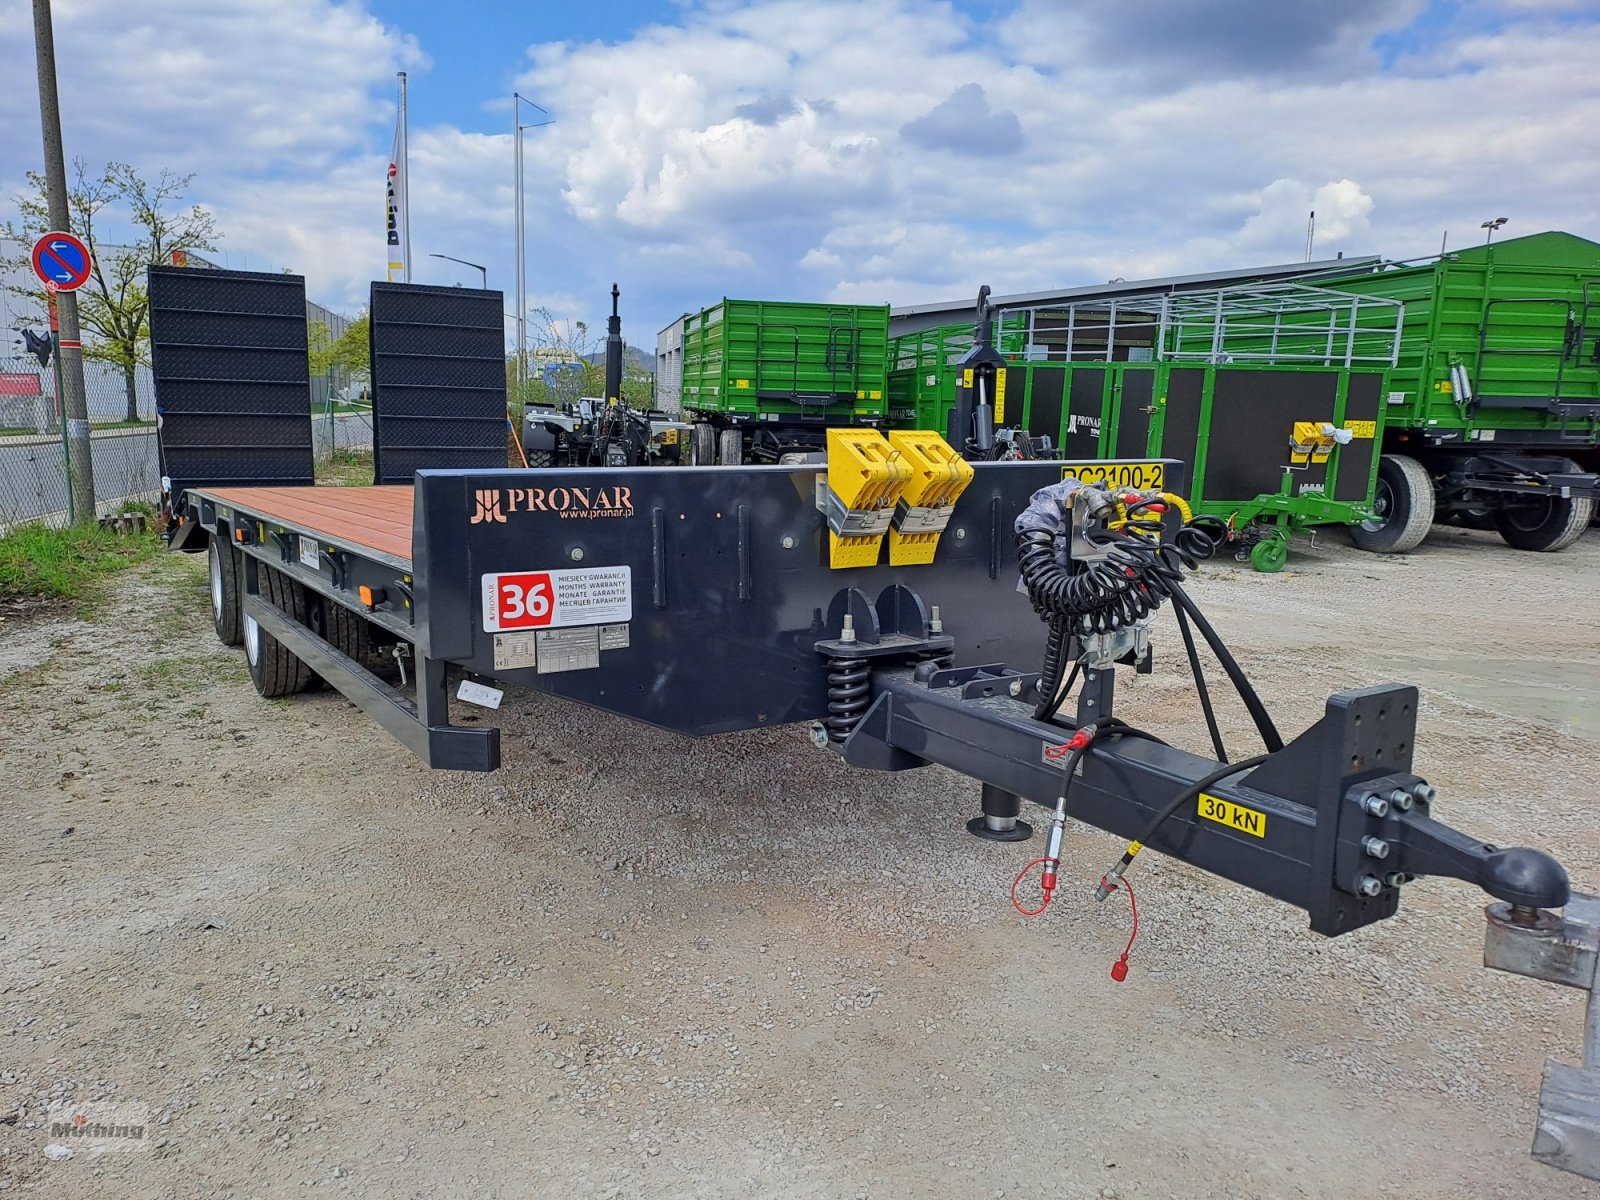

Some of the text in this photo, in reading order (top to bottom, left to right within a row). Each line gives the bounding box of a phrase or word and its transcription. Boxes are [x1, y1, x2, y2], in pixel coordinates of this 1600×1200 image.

[506, 486, 632, 512] PRONAR
[559, 507, 634, 520] www.pronar.pl
[558, 572, 626, 583] MIESIĘCY GWARANCJI
[558, 581, 626, 591] MONTHS WARRANTY
[488, 583, 496, 617] PRONAR
[558, 588, 626, 599] MONATE GARANTIE
[502, 583, 549, 619] 36
[559, 596, 627, 607] МЕСЯЦЕВ ГАРАНТИИ
[1205, 799, 1259, 833] 30 kN
